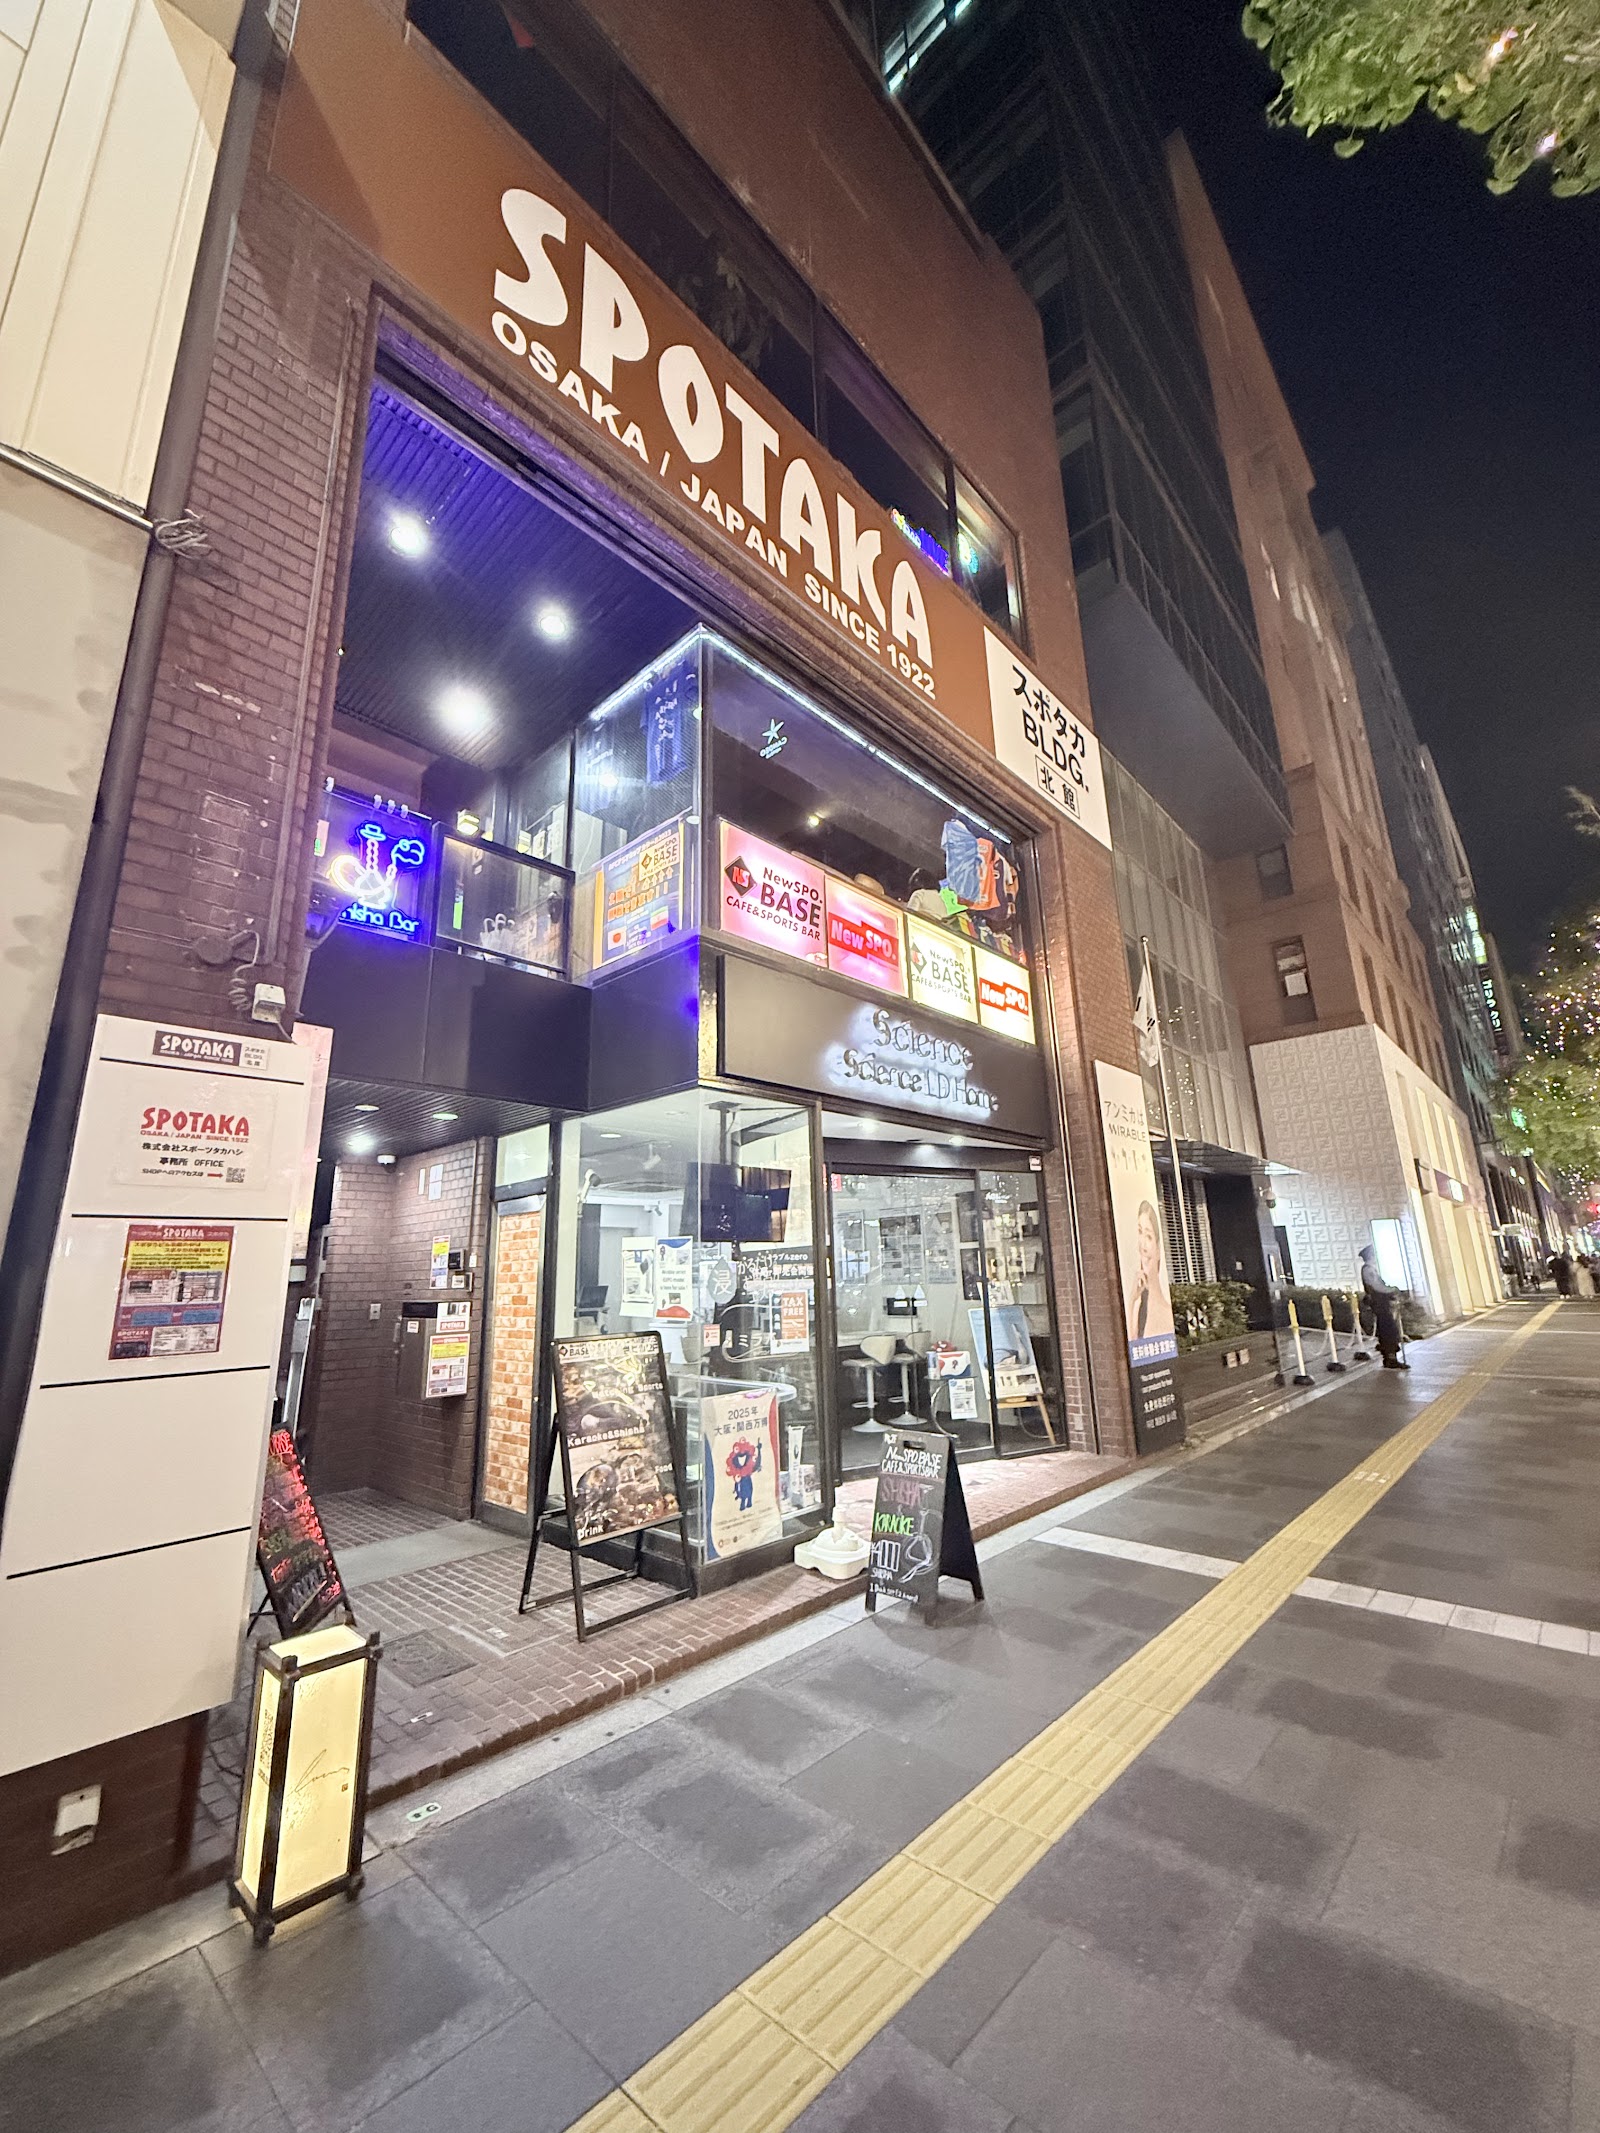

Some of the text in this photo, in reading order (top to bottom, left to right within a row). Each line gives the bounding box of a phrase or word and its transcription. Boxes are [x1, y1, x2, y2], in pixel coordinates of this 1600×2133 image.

[493, 188, 934, 669] SPOTAKA
[491, 311, 648, 463] OSAKA
[679, 472, 788, 578] JAPAN
[803, 572, 881, 655] SINCE
[885, 643, 936, 700] 1922
[1012, 664, 1086, 759] スポタカ
[1021, 708, 1090, 793] BLDG.
[1039, 765, 1077, 813] 北館
[653, 844, 678, 867] BASE
[763, 866, 824, 904] NewSPO.
[760, 882, 822, 929] BASE
[388, 911, 420, 932] Bar
[726, 895, 821, 941] CAFE&SPORTS BAR
[831, 919, 865, 951] New
[931, 960, 970, 994] BASE
[960, 992, 973, 1004] BAR
[981, 982, 1006, 1007] New
[160, 1034, 235, 1059] SPOTAKA
[872, 1008, 974, 1071] Science
[843, 1048, 923, 1093] Science
[952, 1076, 999, 1111] Home
[141, 1107, 250, 1137] SPOTAKA
[140, 1130, 169, 1138] OSAKA
[175, 1132, 202, 1140] JAPAN
[142, 1142, 244, 1156] 株式会社スポーツタカハシ
[194, 1158, 225, 1168] OFFICE
[163, 1228, 205, 1238] SPOTAKA
[782, 1297, 804, 1307] TAX
[783, 1307, 805, 1317] FREE
[569, 1347, 590, 1357] BASE
[637, 1382, 664, 1392] Sports
[728, 1406, 759, 1421] 2025年
[566, 1426, 646, 1448] Karaoke&Shisha
[713, 1416, 769, 1437] 大阪・関西万博
[654, 1463, 673, 1474] Food
[577, 1525, 605, 1540] Drink
